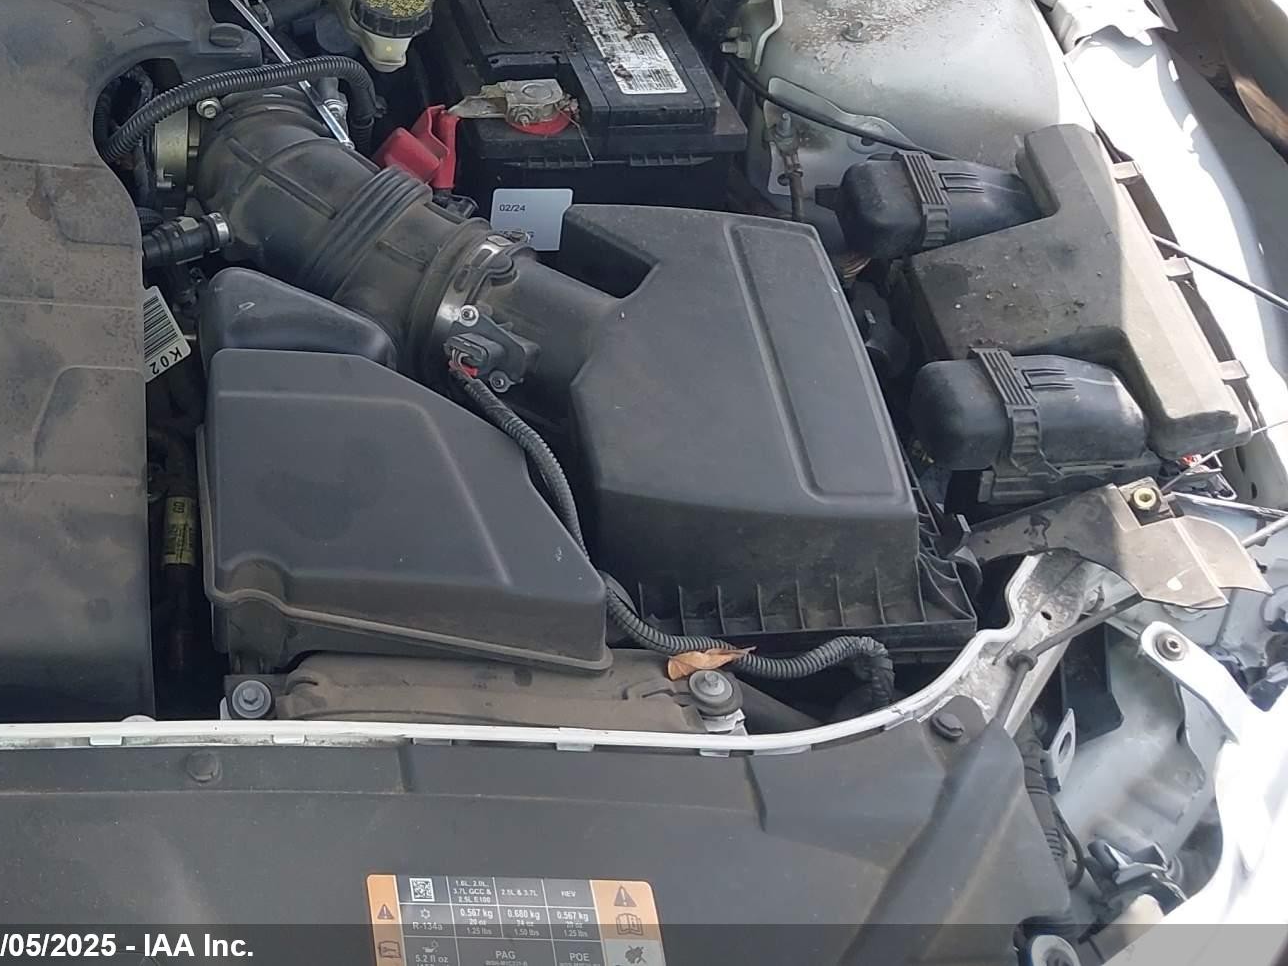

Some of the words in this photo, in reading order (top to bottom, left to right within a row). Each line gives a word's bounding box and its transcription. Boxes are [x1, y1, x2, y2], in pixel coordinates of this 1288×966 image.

[498, 203, 526, 212] 02/24
[149, 347, 183, 375] K02
[460, 908, 481, 917] 0.567
[482, 908, 494, 919] kg
[529, 909, 540, 921] kg
[412, 921, 443, 931] R-134a
[415, 954, 428, 963] 5.2
[495, 950, 516, 960] PAG
[569, 952, 590, 962] POE
